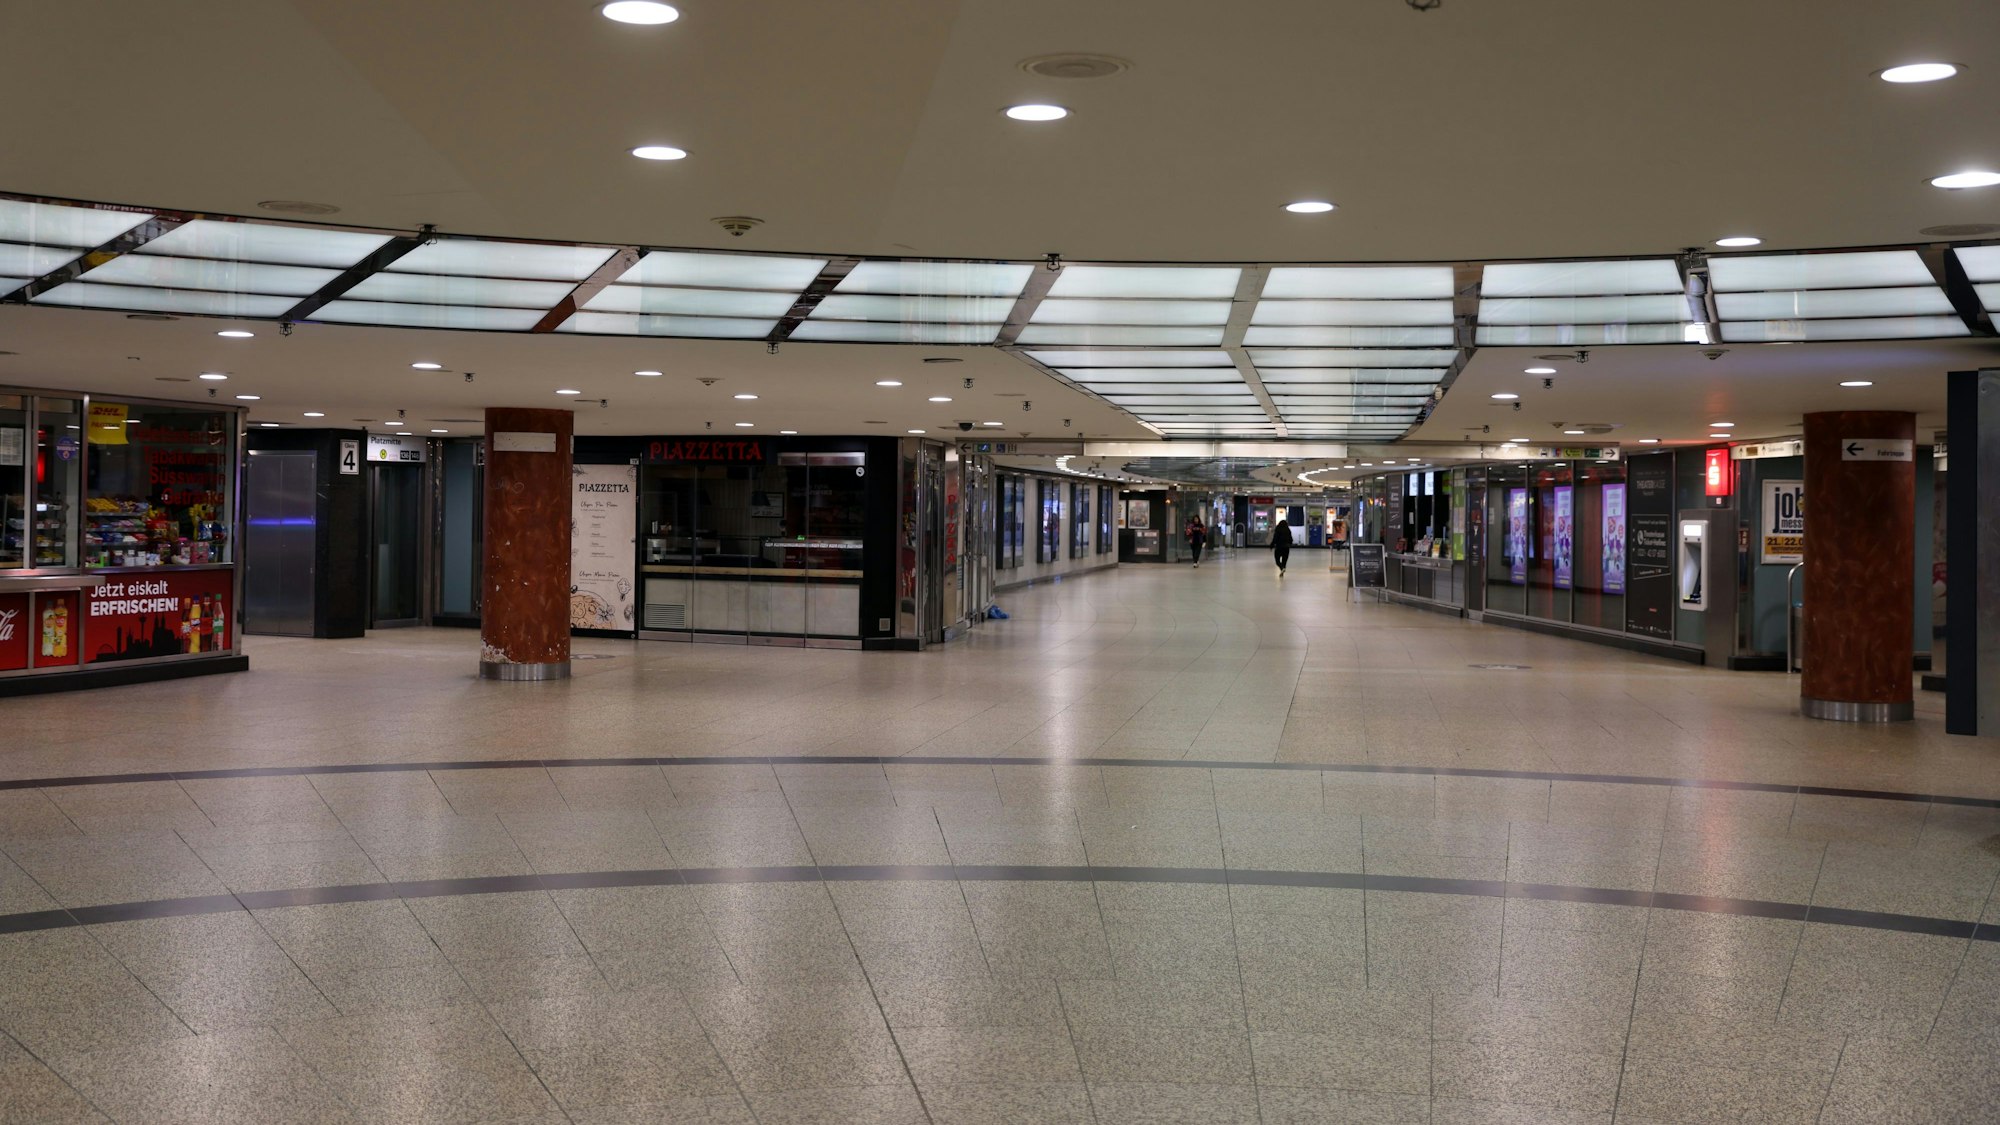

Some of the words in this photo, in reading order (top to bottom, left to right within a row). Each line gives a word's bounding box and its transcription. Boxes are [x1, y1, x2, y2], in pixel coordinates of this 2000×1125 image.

[92, 406, 120, 416] DHL
[370, 436, 402, 446] Platzmitte
[143, 445, 226, 466] Tabakwaren
[650, 441, 762, 461] PIAZZETTA
[343, 450, 355, 470] 4
[150, 467, 226, 484] Süsswaren
[578, 483, 630, 493] PIAZZETTA
[945, 494, 957, 566] PIZZA
[91, 584, 124, 597] Jetzt
[127, 580, 168, 596] eiskalt
[91, 598, 178, 616] ERFRISCHEN!
